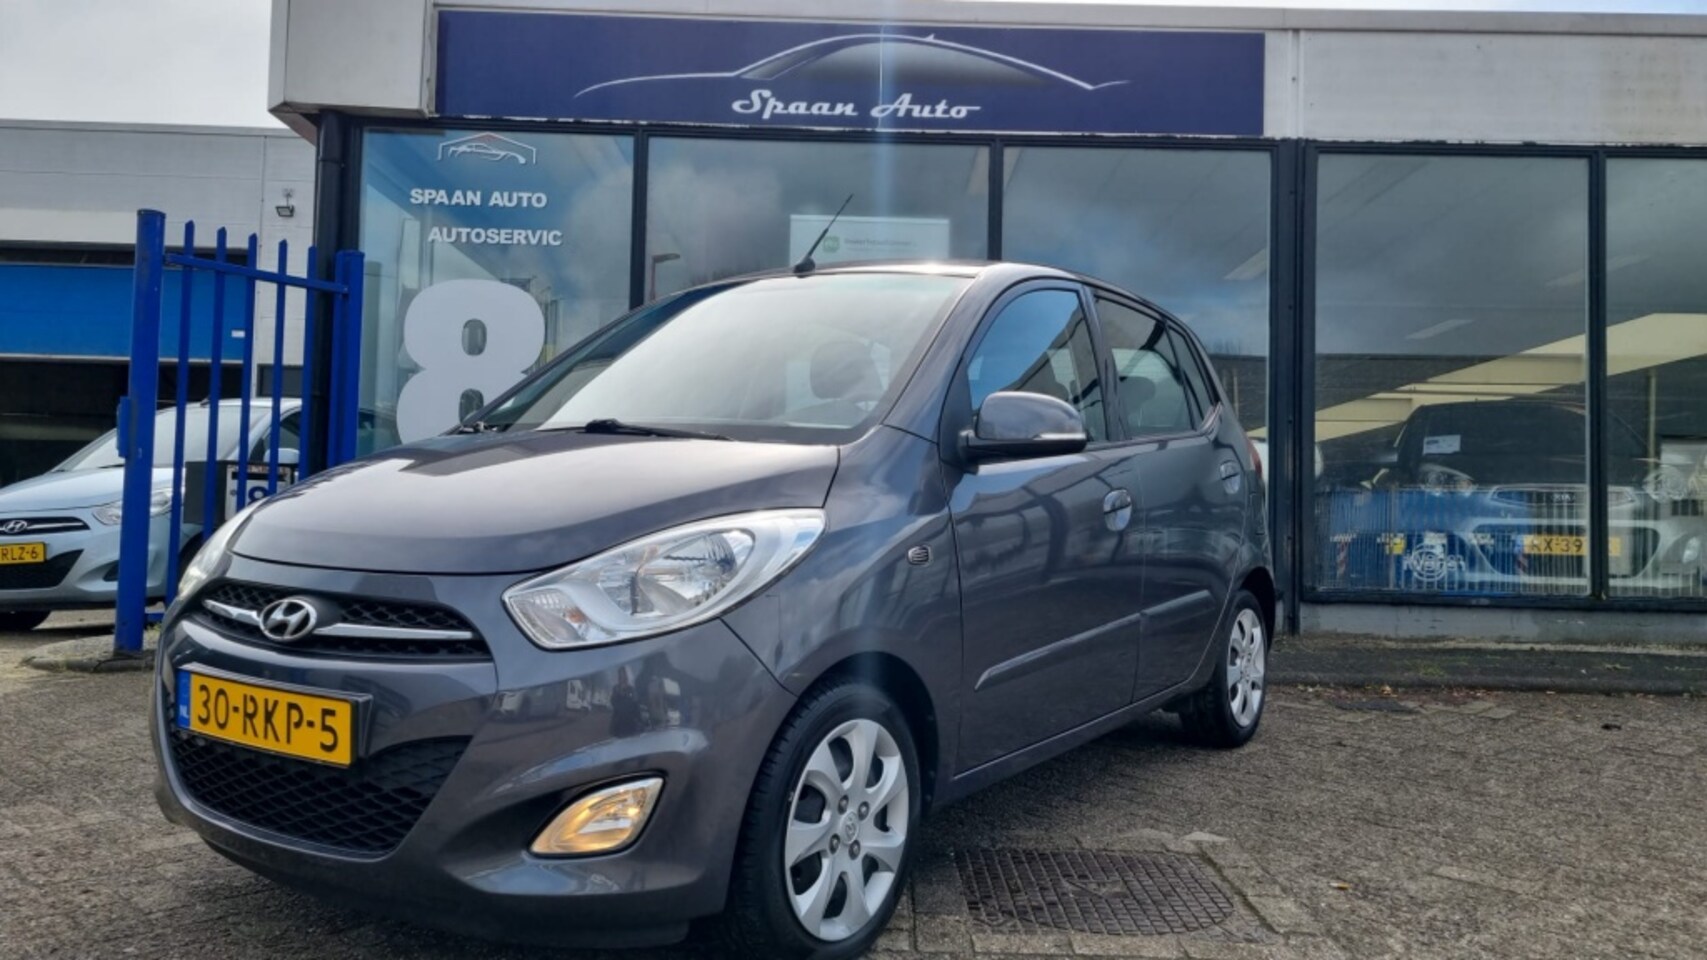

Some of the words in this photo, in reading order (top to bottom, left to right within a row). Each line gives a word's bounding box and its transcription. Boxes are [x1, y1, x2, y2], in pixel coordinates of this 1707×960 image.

[731, 89, 858, 119] Spaan
[870, 93, 981, 118] Auto
[410, 188, 481, 206] SPAAN
[488, 191, 547, 208] AUTO
[428, 226, 562, 246] AUTOSERVIC
[396, 278, 545, 445] 8
[197, 684, 339, 753] 30-RKP-5
